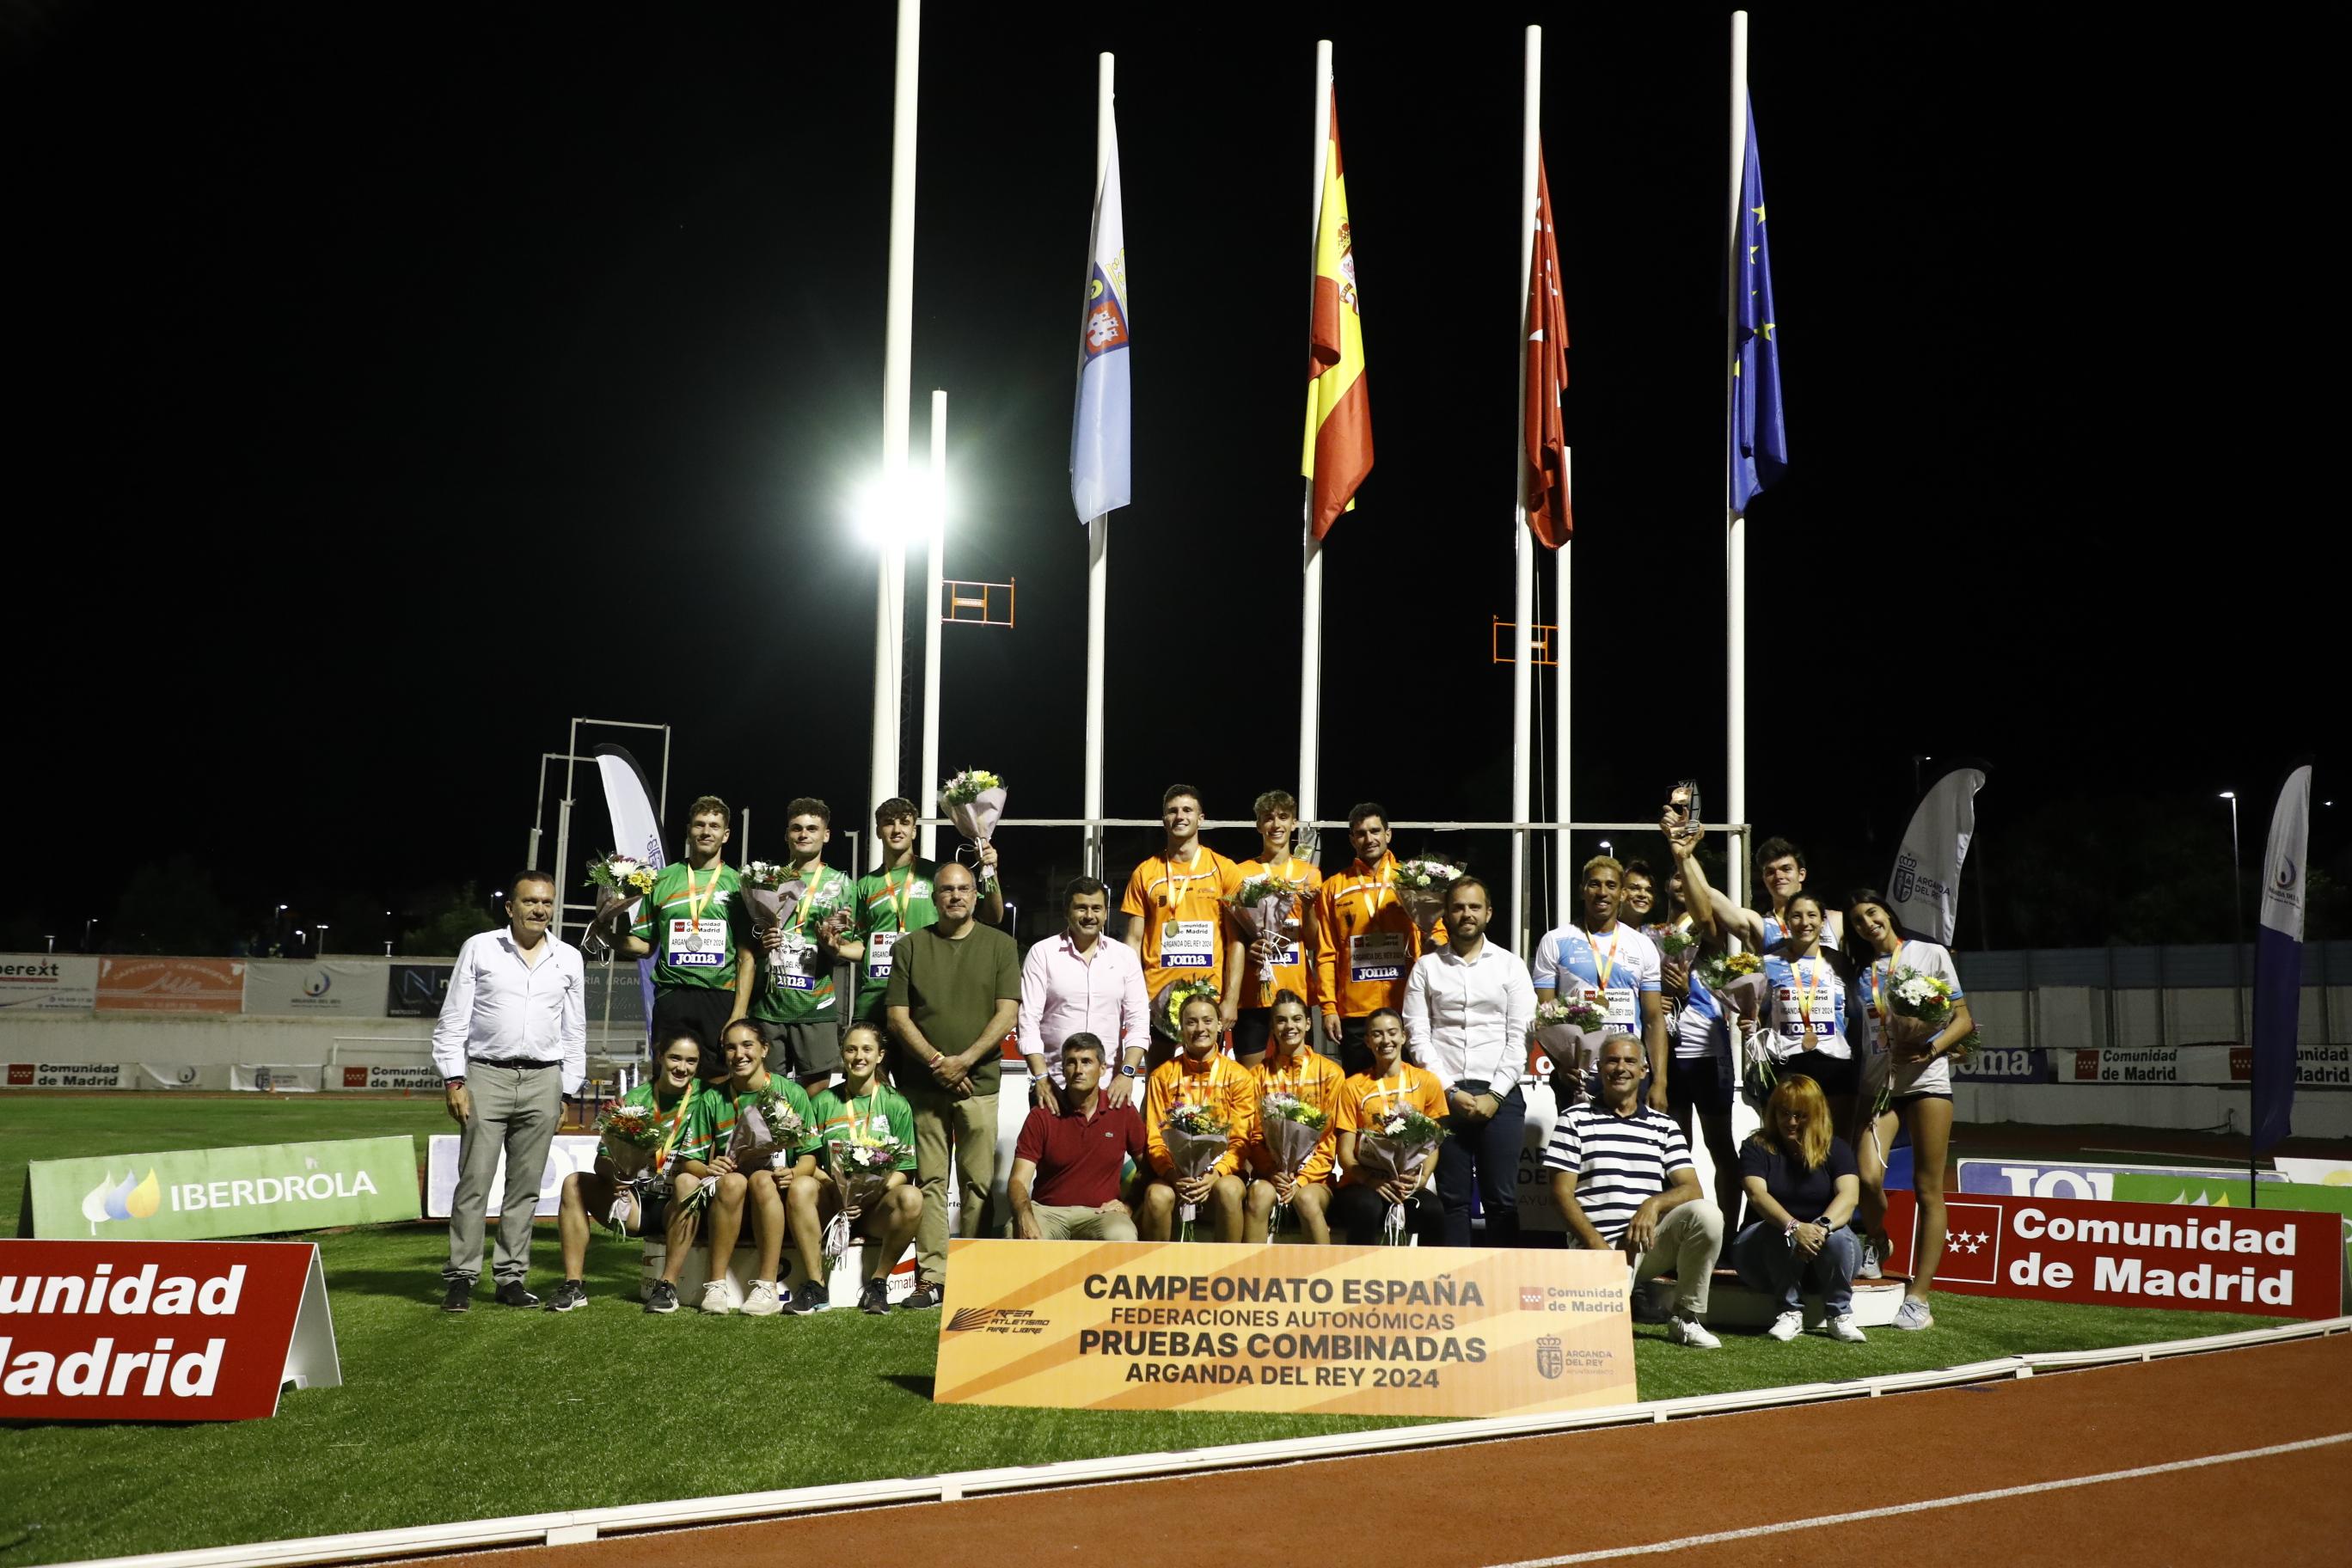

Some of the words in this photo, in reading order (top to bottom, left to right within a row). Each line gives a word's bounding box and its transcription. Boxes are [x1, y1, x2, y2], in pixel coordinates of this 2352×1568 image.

[876, 965, 891, 977] Jo
[2103, 1049, 2177, 1062] Comunidad
[2297, 1047, 2349, 1061] unidad
[38, 1063, 119, 1074] Comunidad
[371, 1066, 432, 1076] Comunid
[1950, 1049, 2032, 1079] oma
[37, 1075, 52, 1086] de
[62, 1075, 118, 1086] Madrid
[2102, 1066, 2119, 1081] de
[2124, 1066, 2177, 1081] Madrid
[371, 1078, 388, 1088] de
[392, 1078, 444, 1088] Madrid
[171, 1170, 378, 1212] IBERDROLA
[2013, 1208, 2296, 1256] Comunidad
[2009, 1253, 2073, 1289] de
[2094, 1257, 2294, 1306] Madrid
[0, 1264, 247, 1314] unidad
[1084, 1274, 1333, 1304] CAMPEONATO
[1342, 1273, 1485, 1307] ESPAÑA
[1547, 1287, 1623, 1298] Comunidad
[1548, 1301, 1566, 1312] de
[1571, 1301, 1624, 1313] Madrid
[1111, 1307, 1279, 1326] FEDERACIONES
[1285, 1308, 1455, 1331] AUTONÓMICAS
[1079, 1329, 1239, 1358] PRUEBAS
[1246, 1332, 1487, 1363] COMBINADAS
[1565, 1350, 1613, 1358] ARGANDA
[0, 1337, 225, 1396] adrid
[1125, 1363, 1254, 1385] ARGANDA
[1261, 1365, 1308, 1386] DEL
[1315, 1366, 1366, 1387] REY
[1373, 1368, 1440, 1388] 2024
